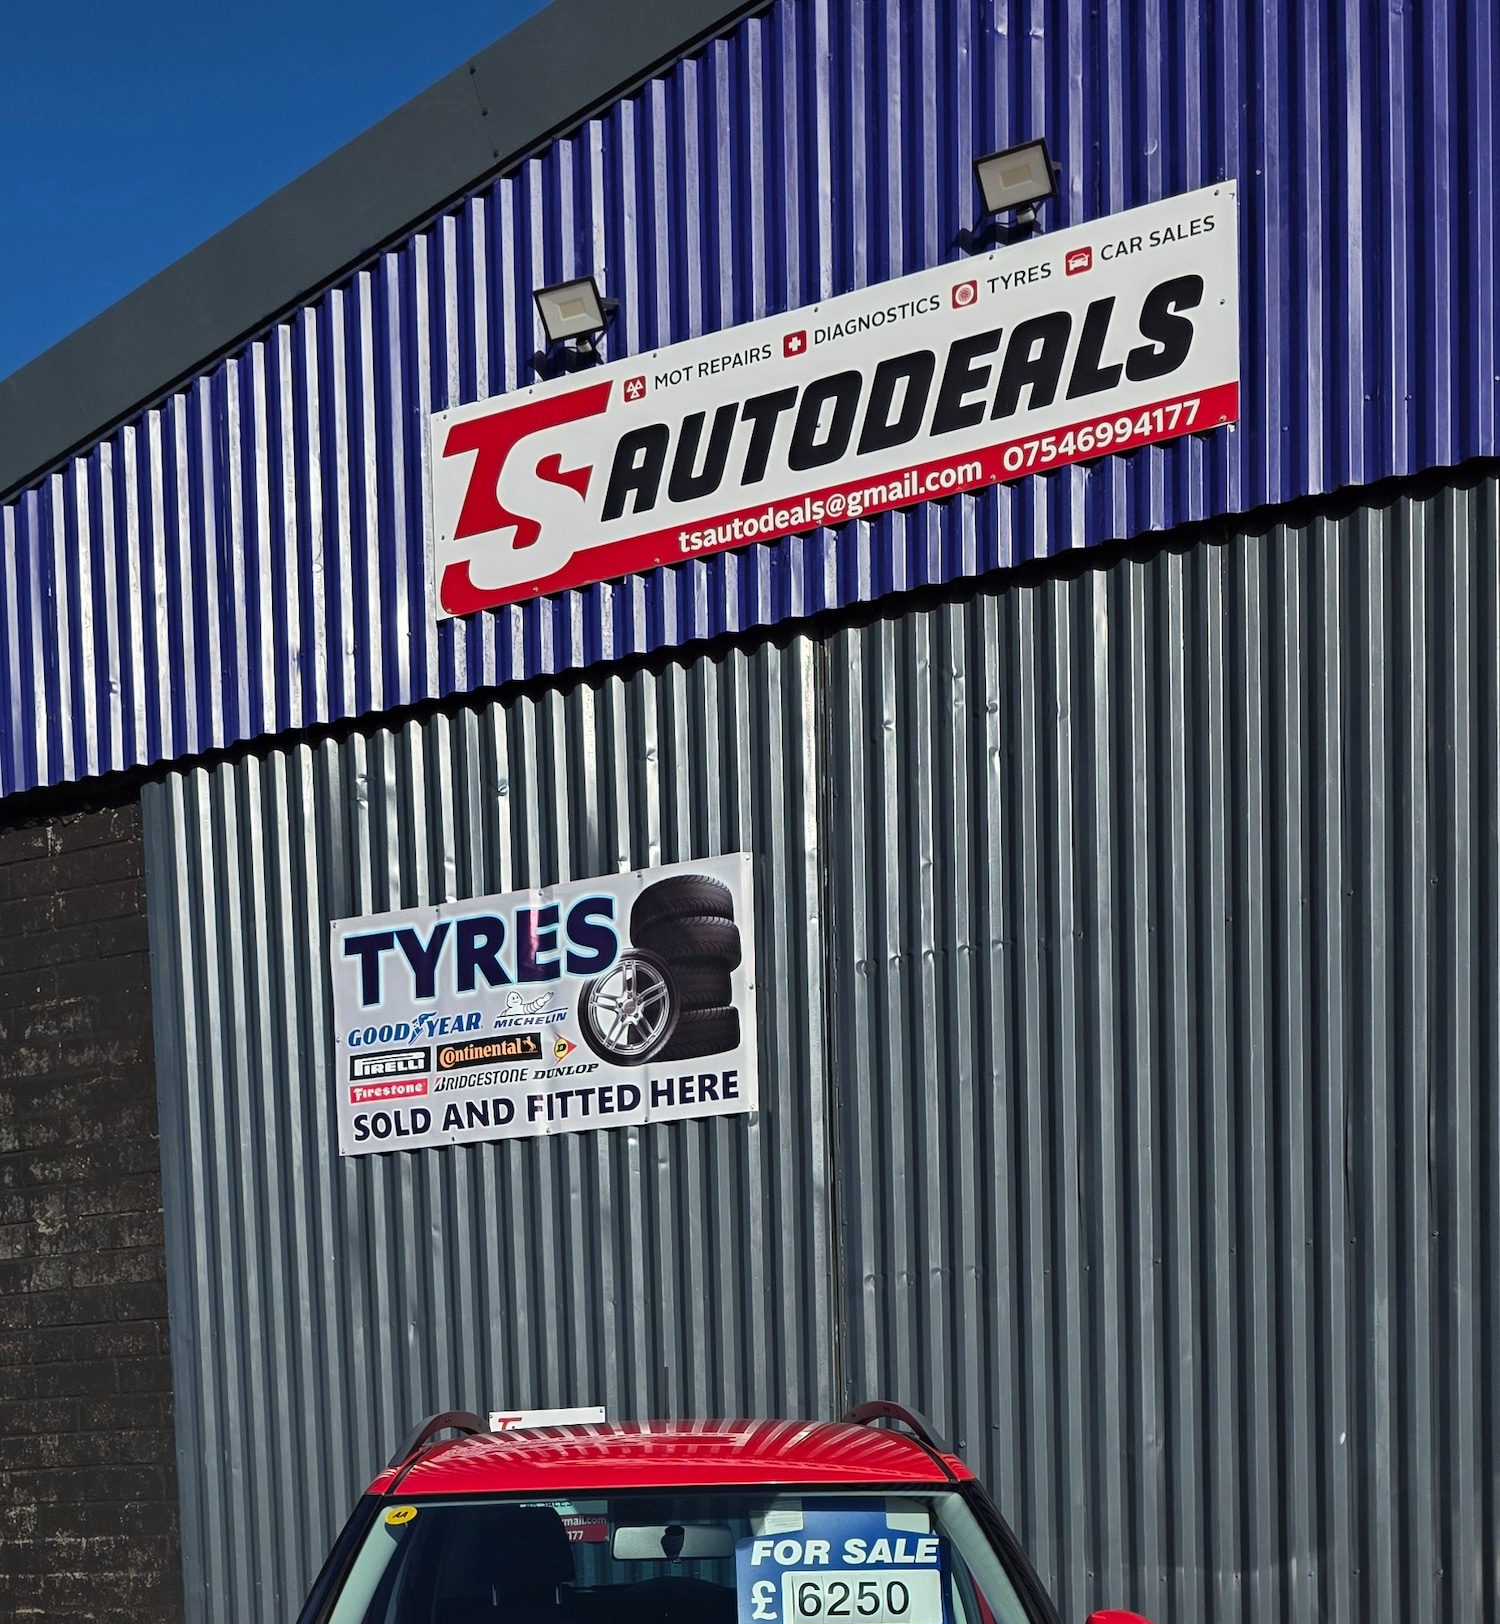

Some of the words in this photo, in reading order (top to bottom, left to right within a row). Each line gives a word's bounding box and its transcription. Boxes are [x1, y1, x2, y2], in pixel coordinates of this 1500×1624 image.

[654, 368, 694, 391] MOT
[698, 343, 773, 378] REPAIRS
[813, 294, 941, 345] DIAGNOSTICS
[986, 261, 1052, 295] TYRES
[1100, 236, 1144, 263] CAR
[1149, 214, 1216, 248] SALES
[600, 274, 1204, 522] AUTODEALS
[678, 459, 983, 553] tsautodeals@gmail.com
[1003, 398, 1201, 472] 07546994177
[344, 898, 617, 1006] TYRES
[494, 1011, 567, 1028] MICHELIN
[353, 1051, 426, 1077] PIRELLI
[439, 1037, 522, 1068] Continental
[433, 1068, 528, 1092] BRIDGESTONE
[532, 1063, 599, 1080] DUNLOP
[353, 1083, 424, 1102] Firestone
[353, 1107, 431, 1141] SOLD
[442, 1099, 515, 1131] AND
[527, 1083, 641, 1122] FITTED
[651, 1070, 740, 1107] HERE
[751, 1540, 831, 1566] FOR
[842, 1538, 940, 1564] SALE
[751, 1580, 778, 1620] £
[798, 1580, 909, 1617] 6250
